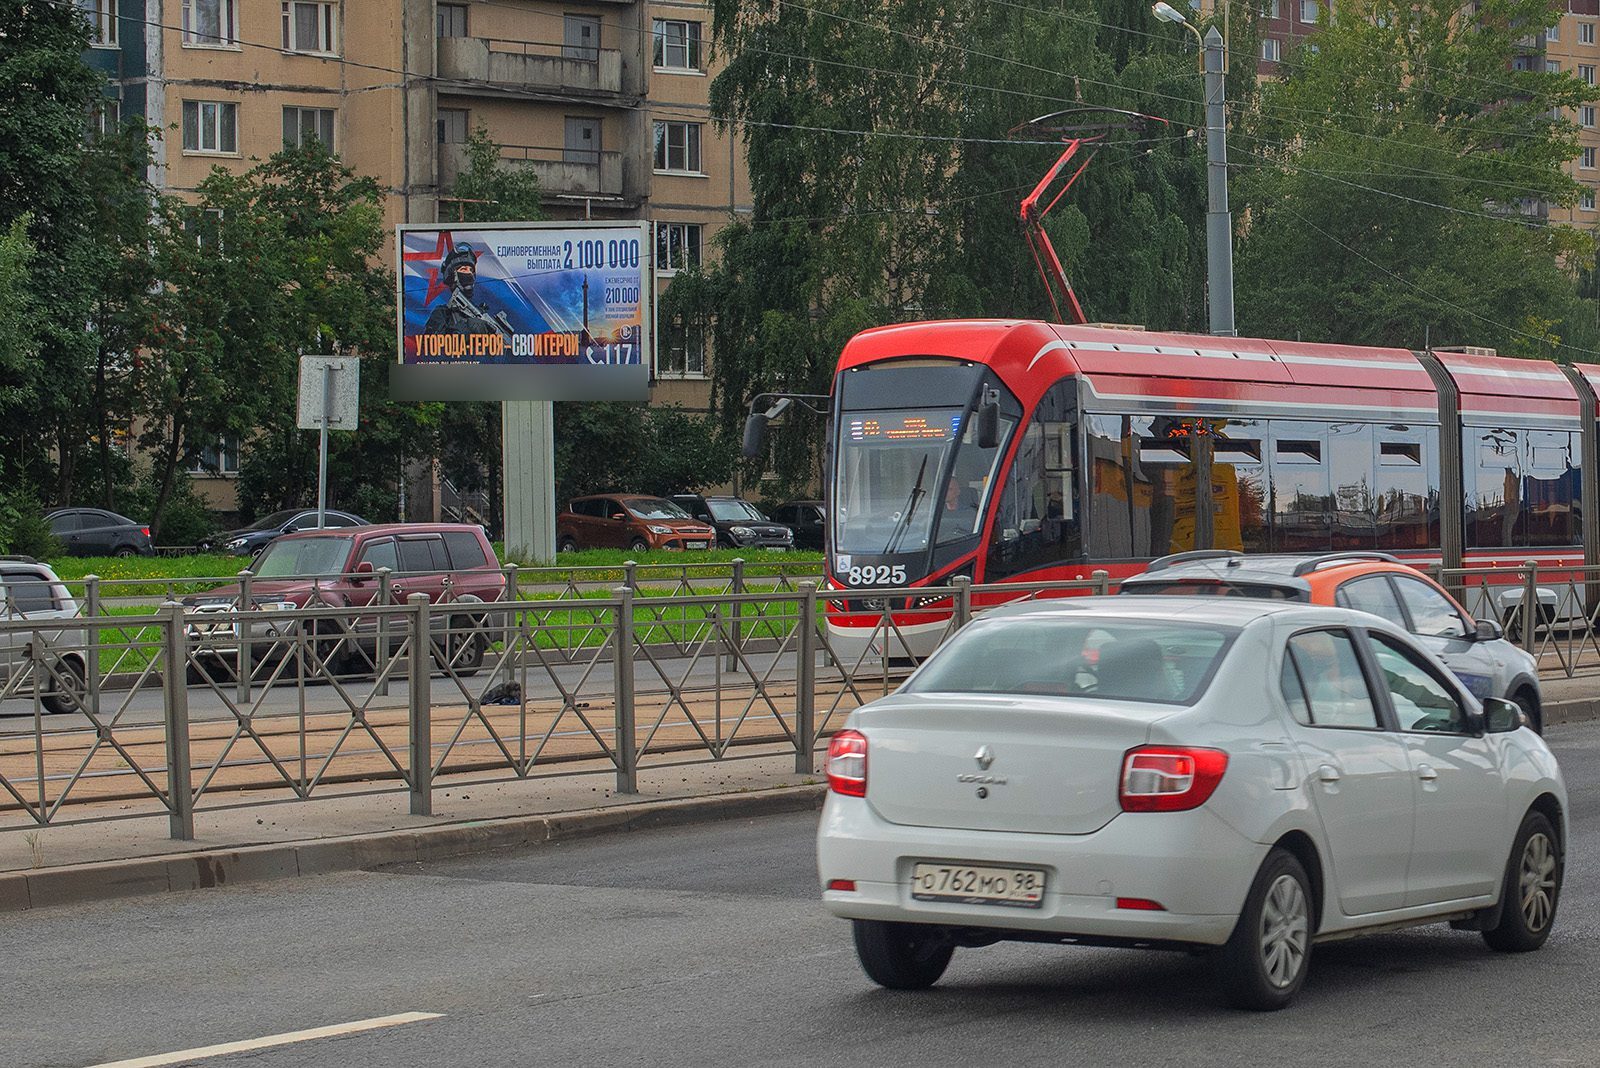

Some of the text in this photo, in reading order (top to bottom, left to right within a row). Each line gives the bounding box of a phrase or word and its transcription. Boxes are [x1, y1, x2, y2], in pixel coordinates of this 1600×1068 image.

[497, 245, 561, 257] ЕДИНОВРЕМЕННАЯ
[563, 239, 639, 269] 2 100 000
[527, 258, 562, 270] ВЫПЛАТА
[605, 287, 639, 304] 210 000
[415, 333, 423, 356] У
[423, 333, 504, 359] ГОРОДА-ГЕРОЯ
[512, 333, 543, 356] СВОИ
[543, 333, 579, 356] ГЕРОИ
[848, 564, 907, 585] 8925
